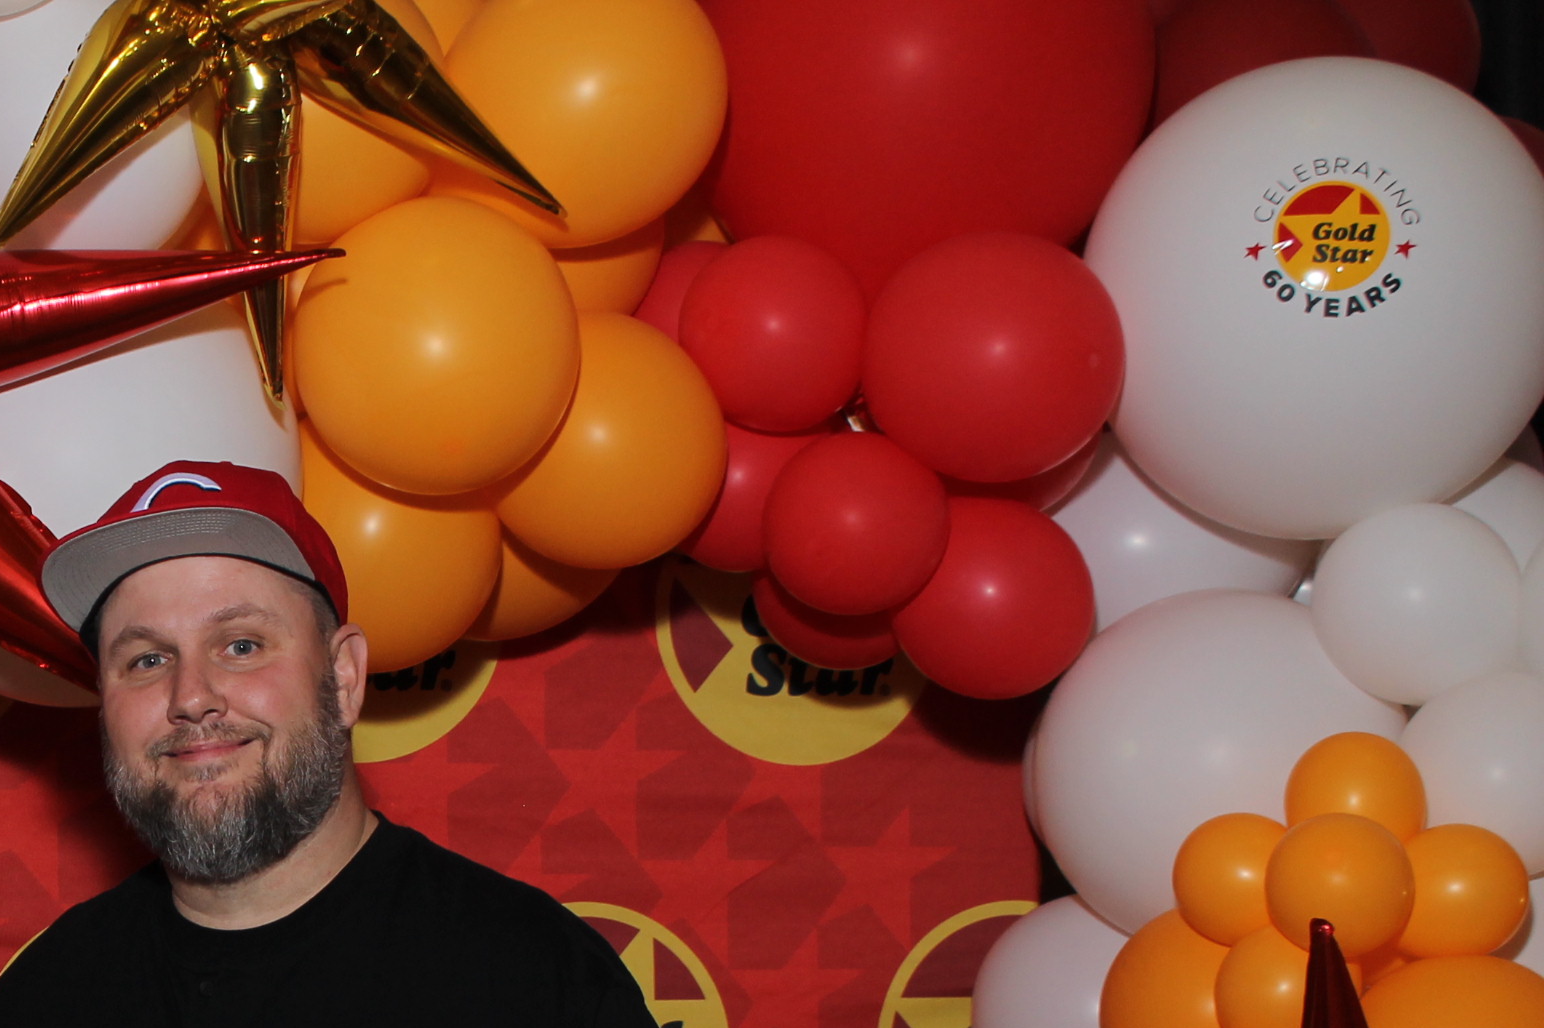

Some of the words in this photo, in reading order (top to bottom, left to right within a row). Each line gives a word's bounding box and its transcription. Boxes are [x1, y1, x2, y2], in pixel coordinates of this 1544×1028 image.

[1253, 157, 1421, 226] CELEBRATING
[1312, 222, 1377, 242] Gold
[1312, 244, 1374, 264] Star
[1262, 270, 1296, 302] 60
[1304, 272, 1402, 318] YEARS
